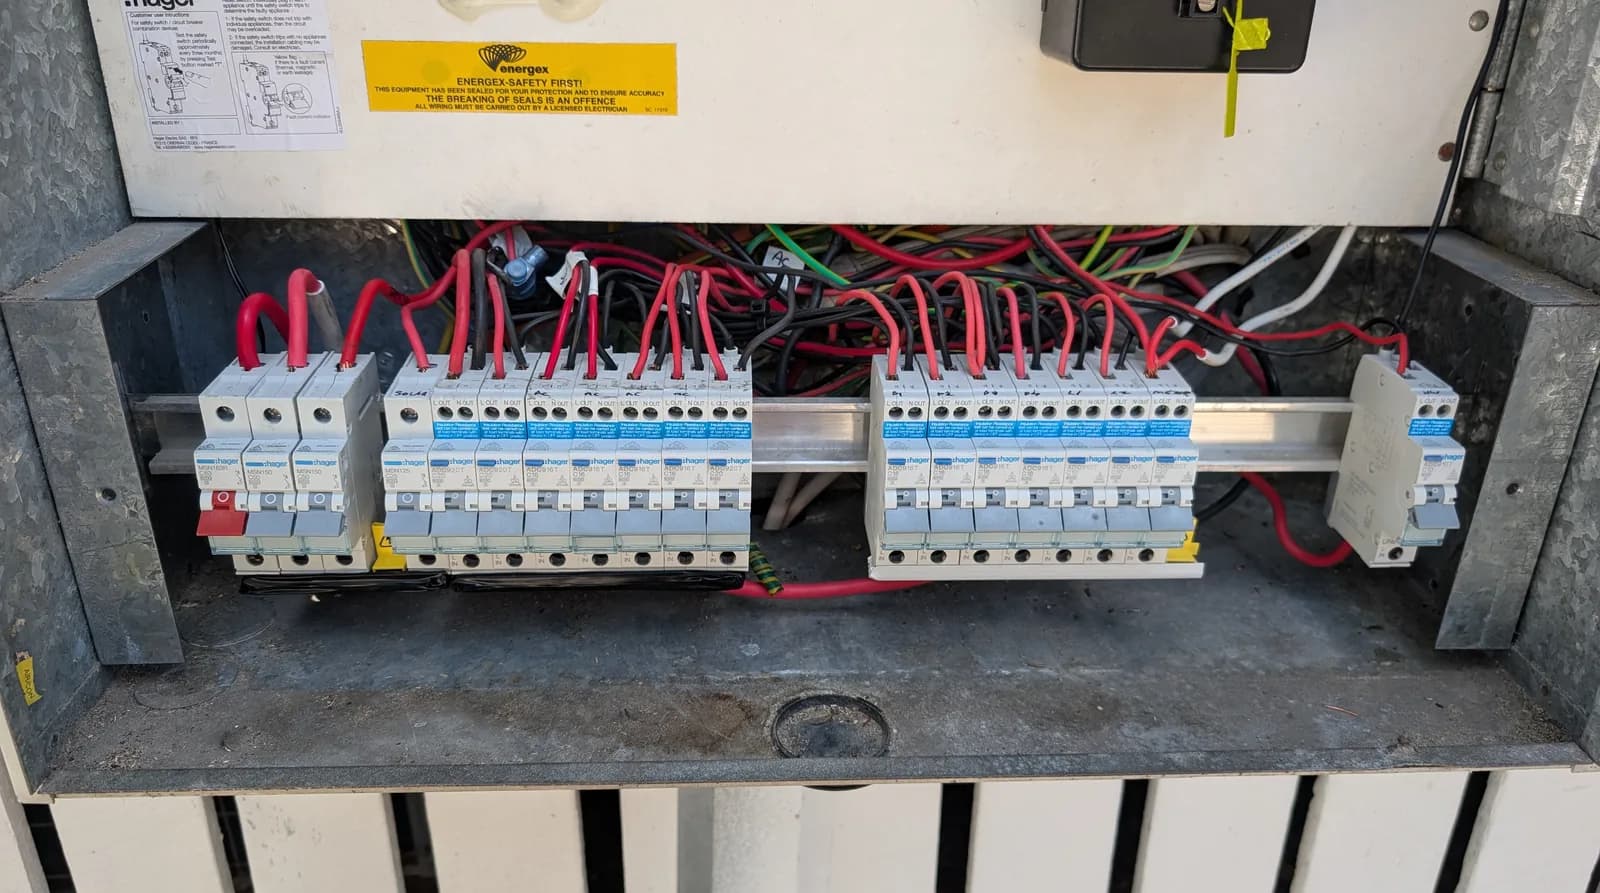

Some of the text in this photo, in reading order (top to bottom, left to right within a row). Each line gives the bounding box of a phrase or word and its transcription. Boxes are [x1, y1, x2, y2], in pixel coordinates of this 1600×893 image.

[500, 65, 549, 76] energex
[457, 77, 583, 88] ENERGEX-SAFETY FIRST!
[426, 95, 444, 103] THE
[447, 95, 495, 103] BREAKING
[513, 96, 543, 104] SEALS
[546, 96, 554, 104] IS
[573, 97, 616, 105] OFFENCE
